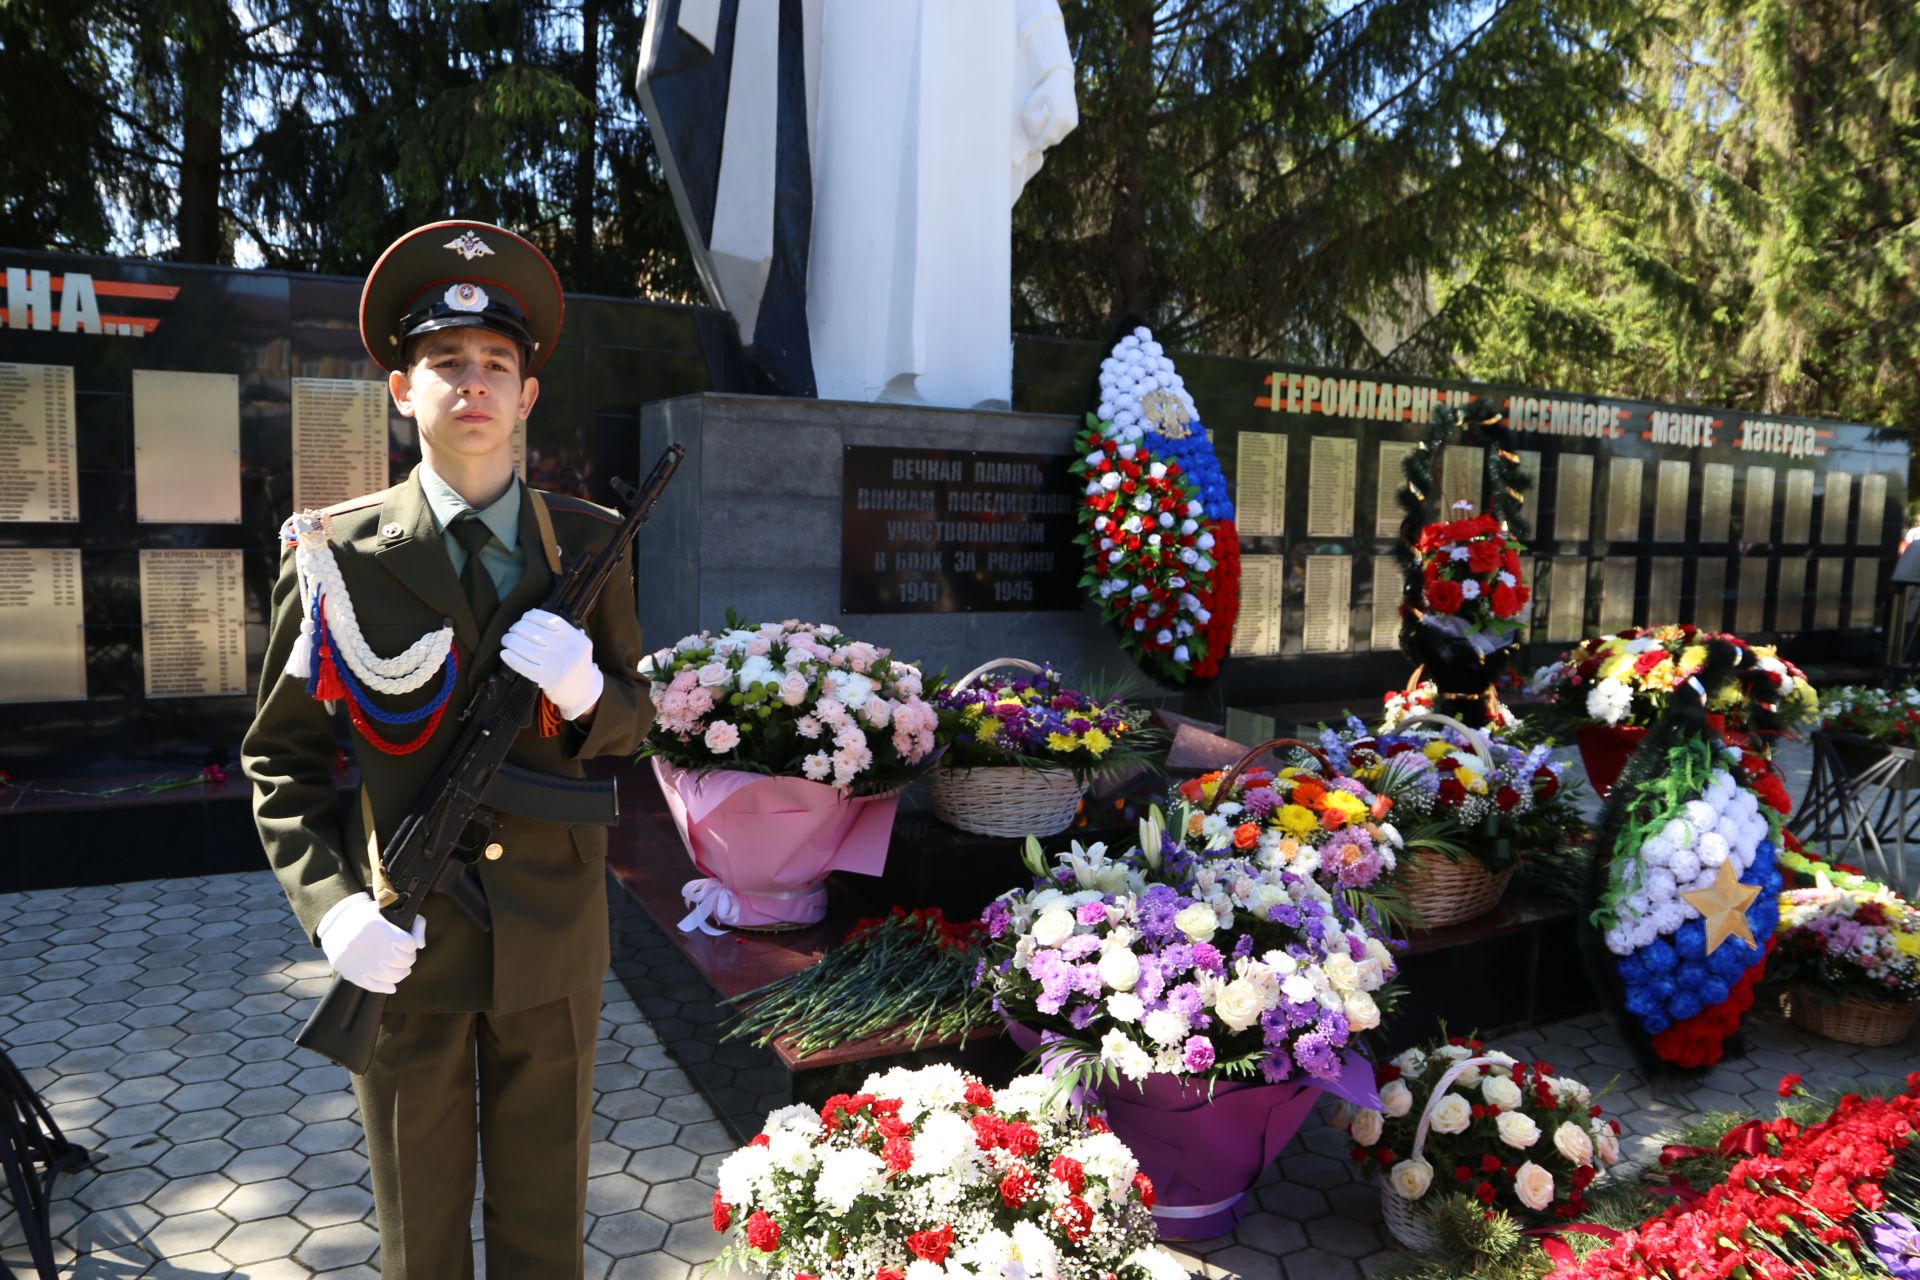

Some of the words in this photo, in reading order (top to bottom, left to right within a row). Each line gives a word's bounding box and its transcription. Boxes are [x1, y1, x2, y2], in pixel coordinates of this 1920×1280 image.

[0, 267, 144, 337] НА...
[1651, 411, 1714, 448] МӘҢГЕ
[892, 459, 962, 482] ВЕЧНАЯ
[974, 462, 1044, 484] ПАМЯТЬ
[857, 488, 935, 512] ВОИНАМ
[948, 491, 1072, 515] ПОБЕДИТЕЛЯМ
[887, 521, 1045, 543] УЧАСТВОВАВШИМ
[874, 551, 886, 571] В
[895, 552, 942, 571] БОЯХ
[954, 552, 976, 571] ЗА
[987, 552, 1055, 573] РОДИНУ
[899, 582, 938, 602] 1941
[993, 580, 1033, 601] 1945
